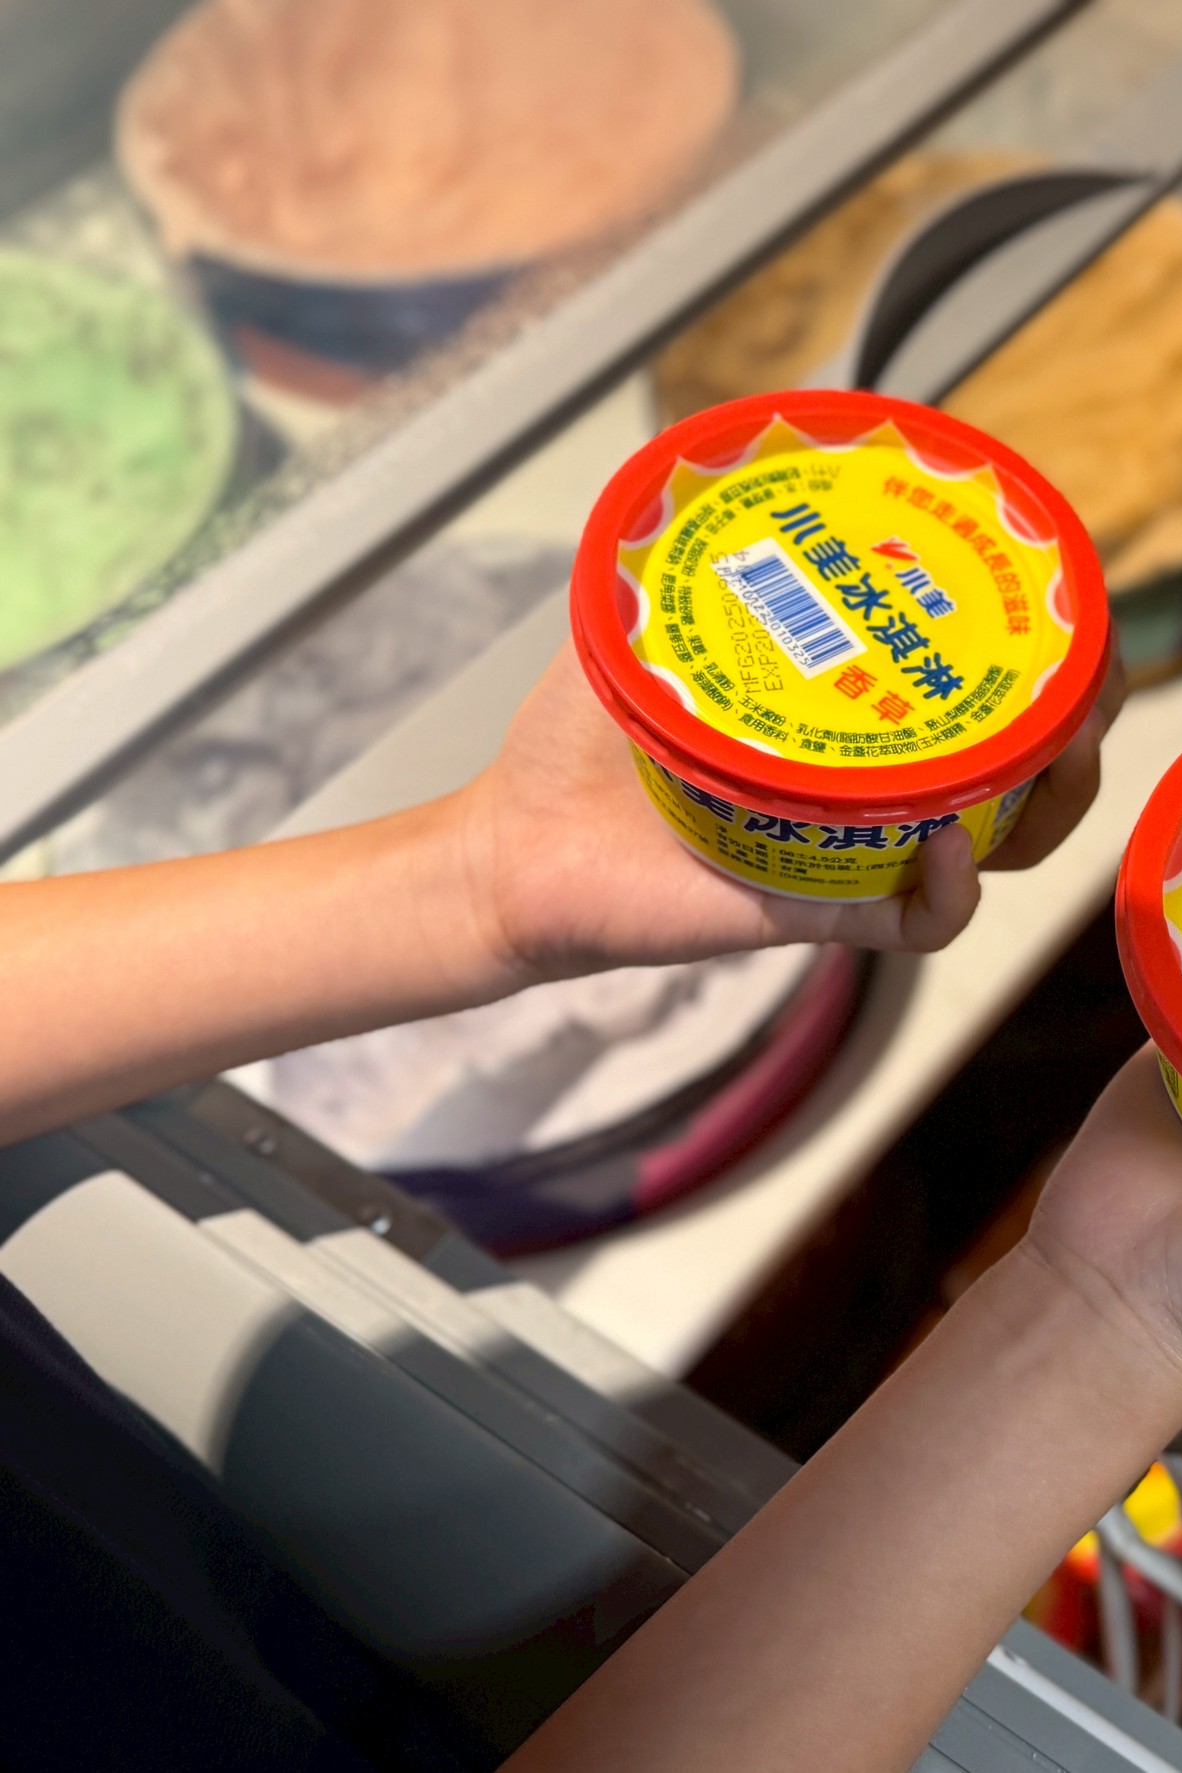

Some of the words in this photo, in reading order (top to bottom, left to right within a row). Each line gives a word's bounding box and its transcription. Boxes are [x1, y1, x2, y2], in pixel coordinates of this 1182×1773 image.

[771, 503, 964, 700] 小美冰淇淋
[883, 476, 1031, 636] 伴您走過成長的滋味
[895, 568, 954, 618] 小美
[834, 665, 915, 725] 香草
